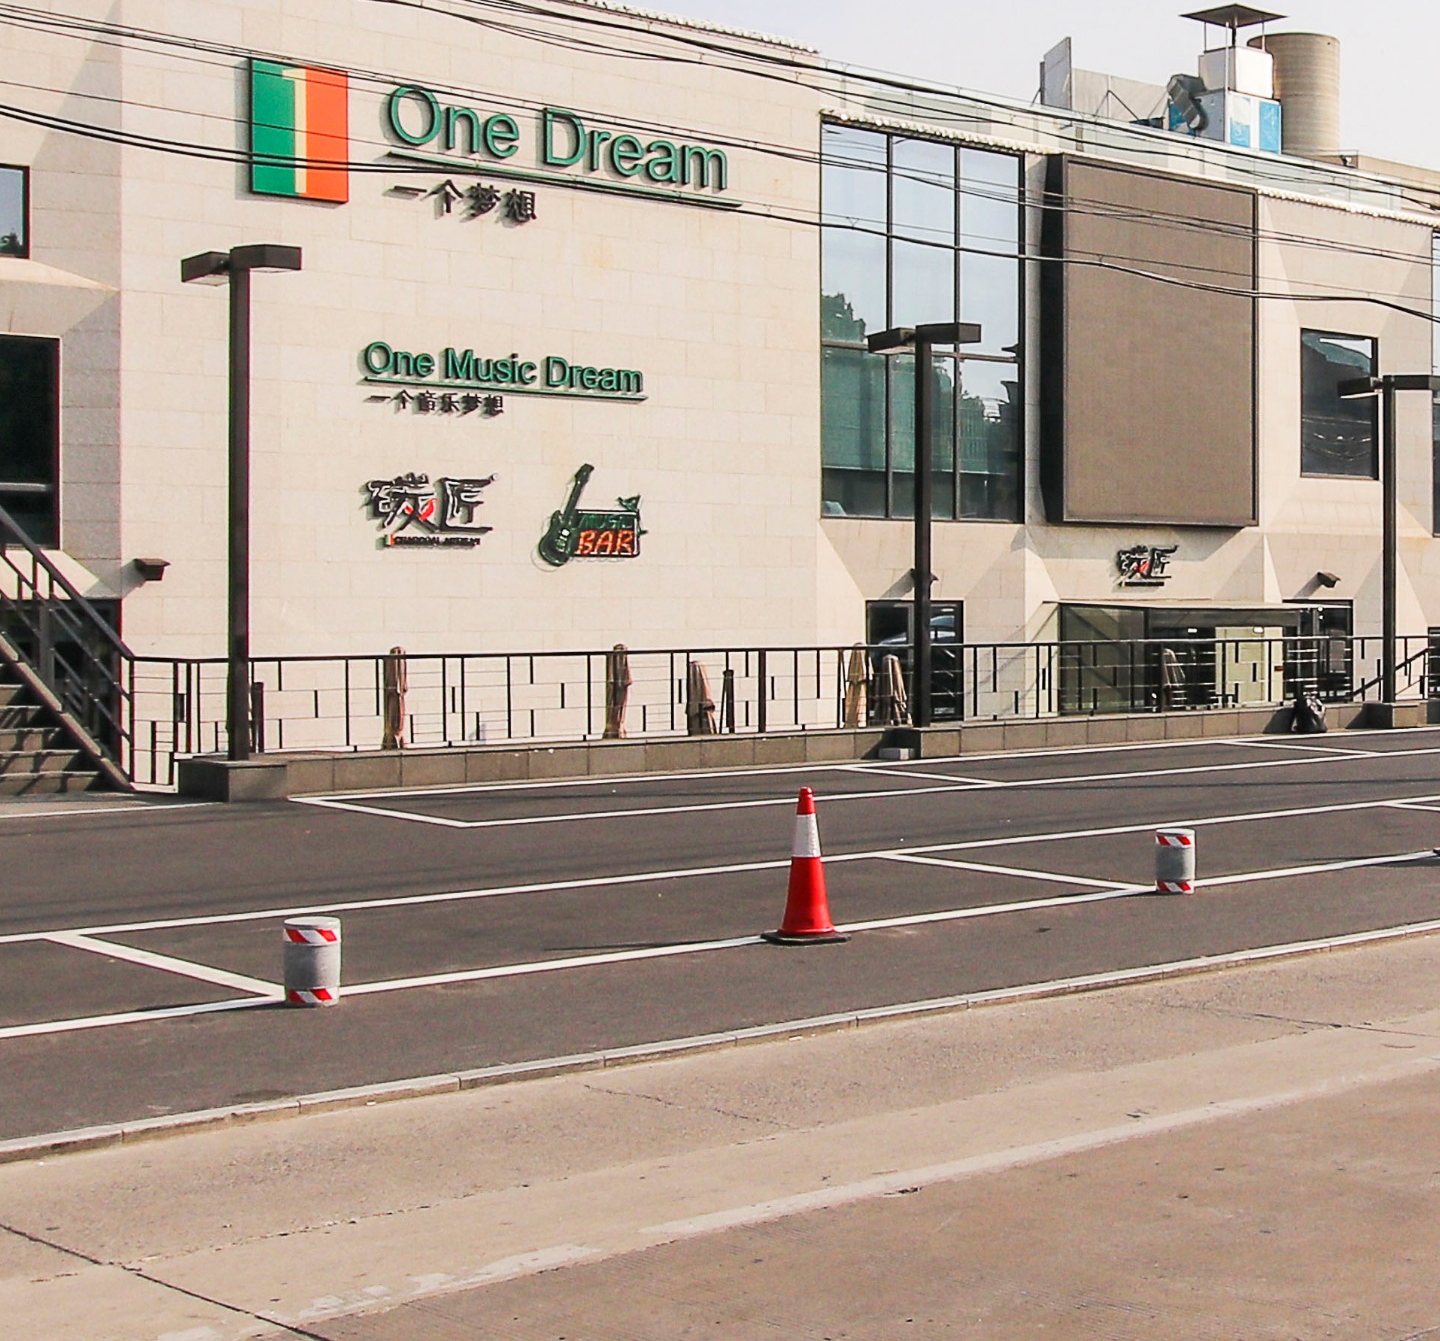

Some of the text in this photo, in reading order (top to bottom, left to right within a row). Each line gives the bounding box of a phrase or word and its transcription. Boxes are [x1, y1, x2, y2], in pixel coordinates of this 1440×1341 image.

[388, 84, 728, 191] One Dream
[388, 179, 538, 225] 一个梦想
[363, 340, 645, 394] One Music Dream
[367, 389, 505, 416] 一个音乐梦想
[575, 529, 635, 555] BAR
